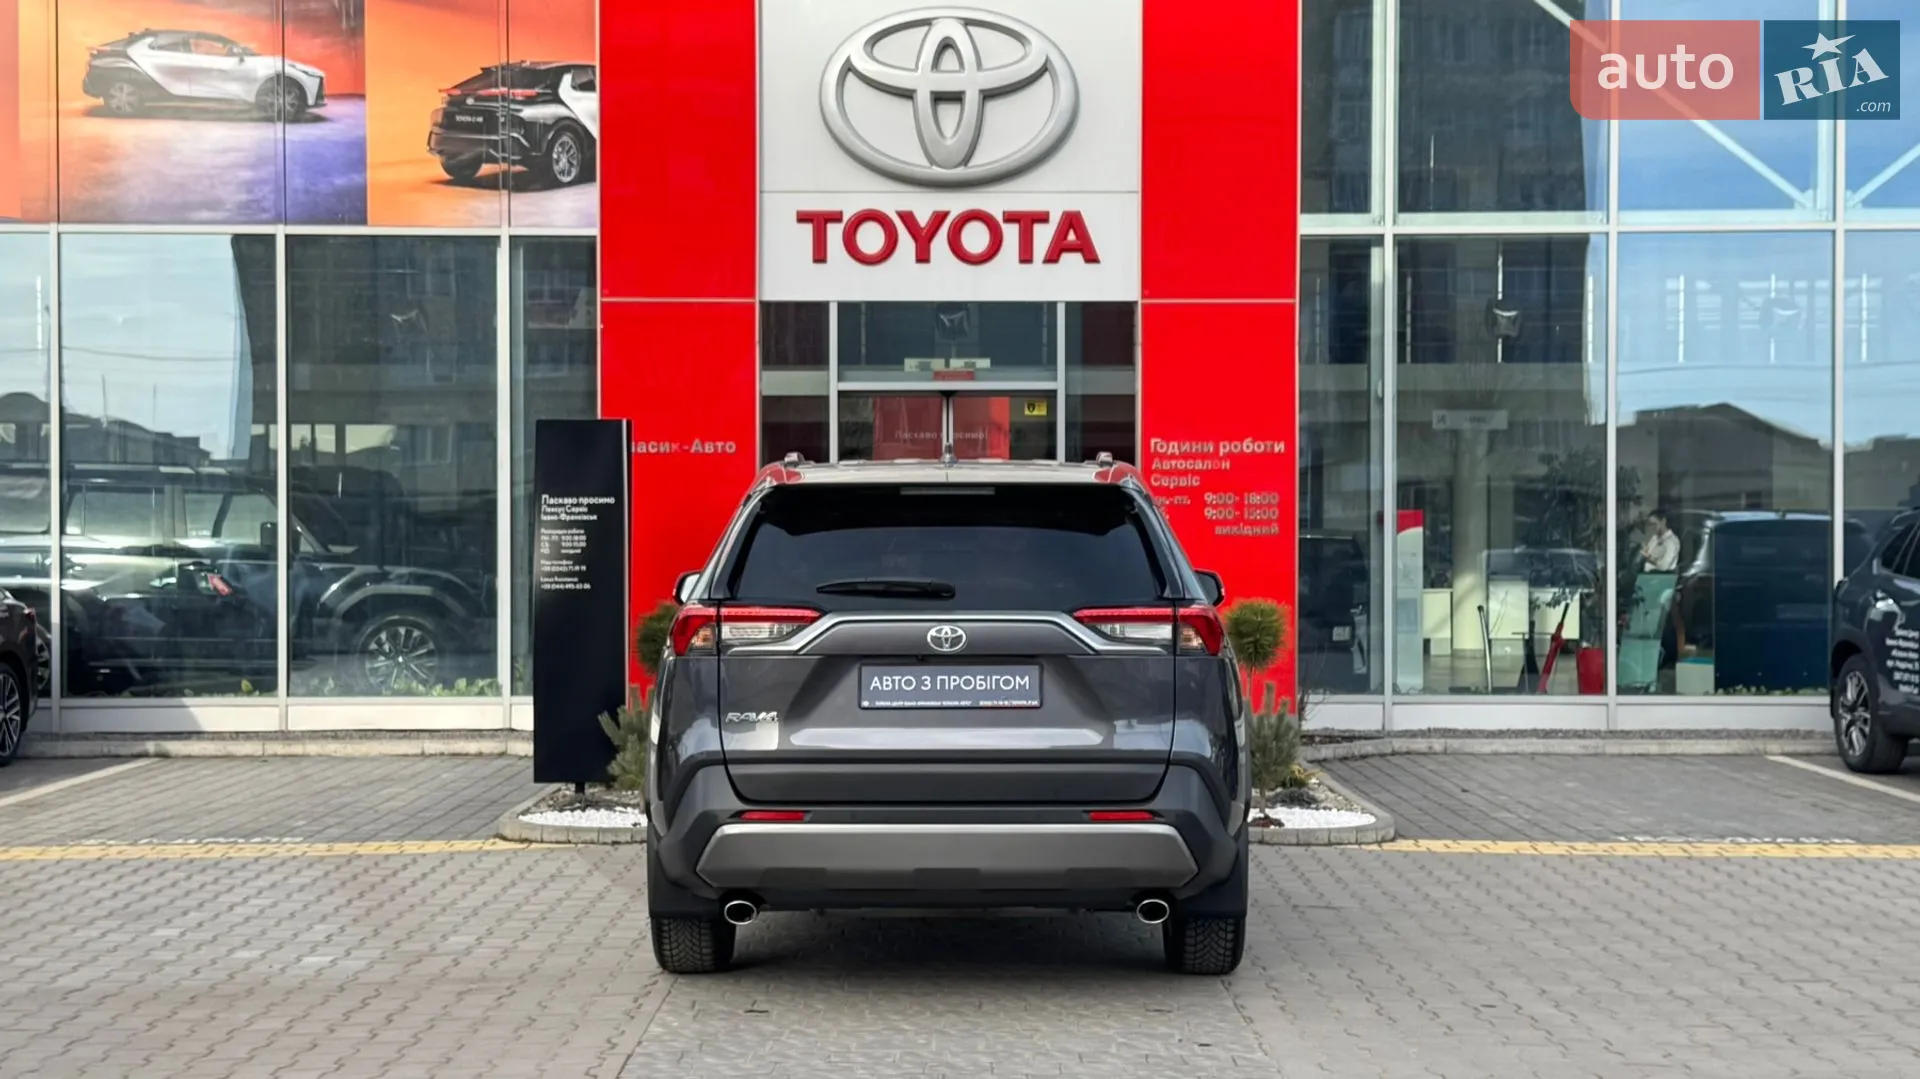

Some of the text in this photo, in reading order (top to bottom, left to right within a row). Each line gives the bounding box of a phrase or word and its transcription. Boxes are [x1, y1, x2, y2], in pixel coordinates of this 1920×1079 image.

[796, 208, 1101, 266] TOYOTA
[1150, 437, 1286, 457] Години роботи
[1152, 458, 1231, 471] Автосалон
[1150, 473, 1201, 489] Сервіс
[870, 675, 1030, 691] АВТО З ПРОБІГОМ
[725, 711, 778, 723] RAV4
